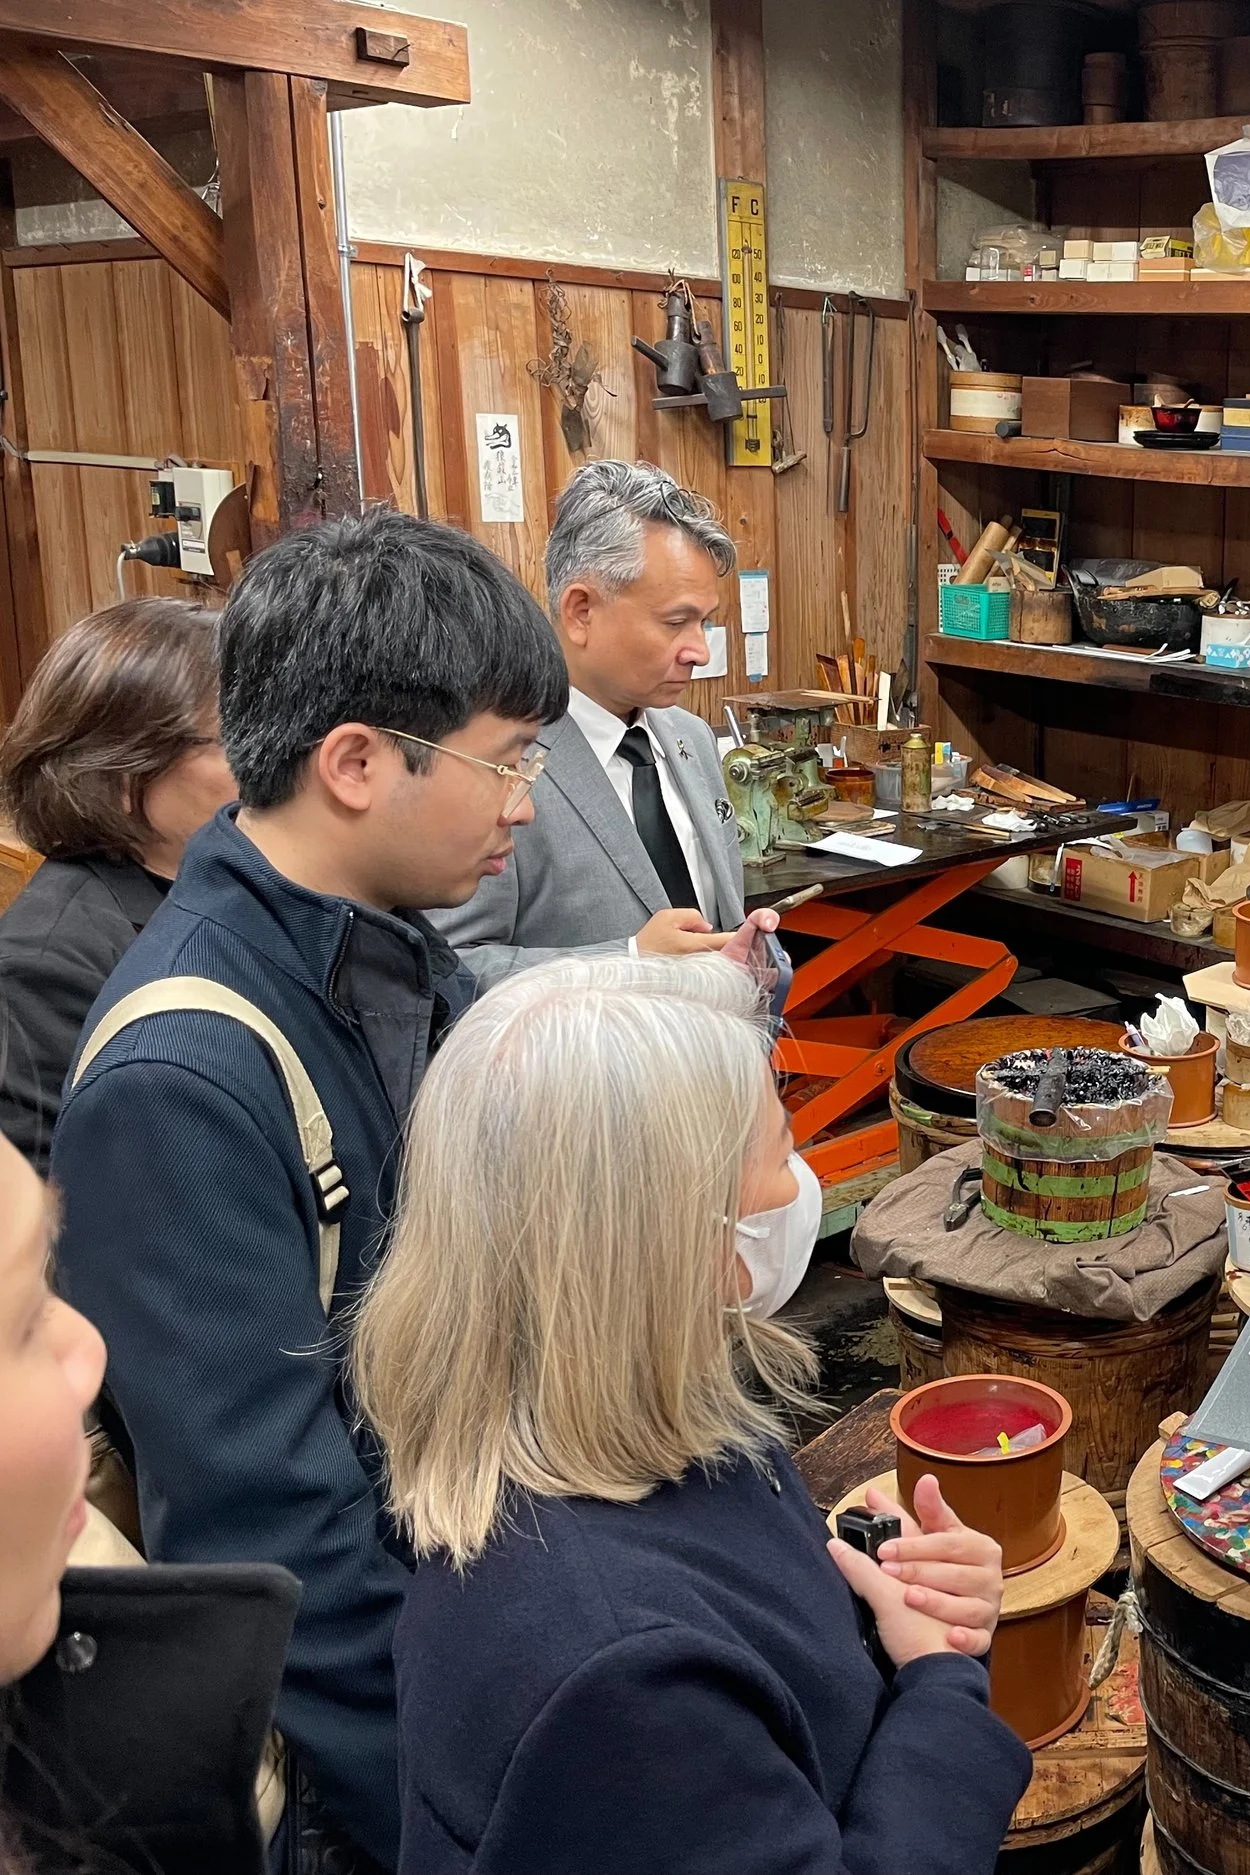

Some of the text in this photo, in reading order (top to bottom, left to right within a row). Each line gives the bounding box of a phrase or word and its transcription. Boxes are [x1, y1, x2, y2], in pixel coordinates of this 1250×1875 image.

[731, 195, 760, 216] F C
[753, 248, 763, 260] 50
[753, 271, 763, 283] 40
[732, 292, 764, 308] 80 30
[733, 313, 765, 332] 60 20
[734, 334, 764, 354] 40 10
[735, 353, 764, 377] 20 0
[757, 373, 766, 385] 10
